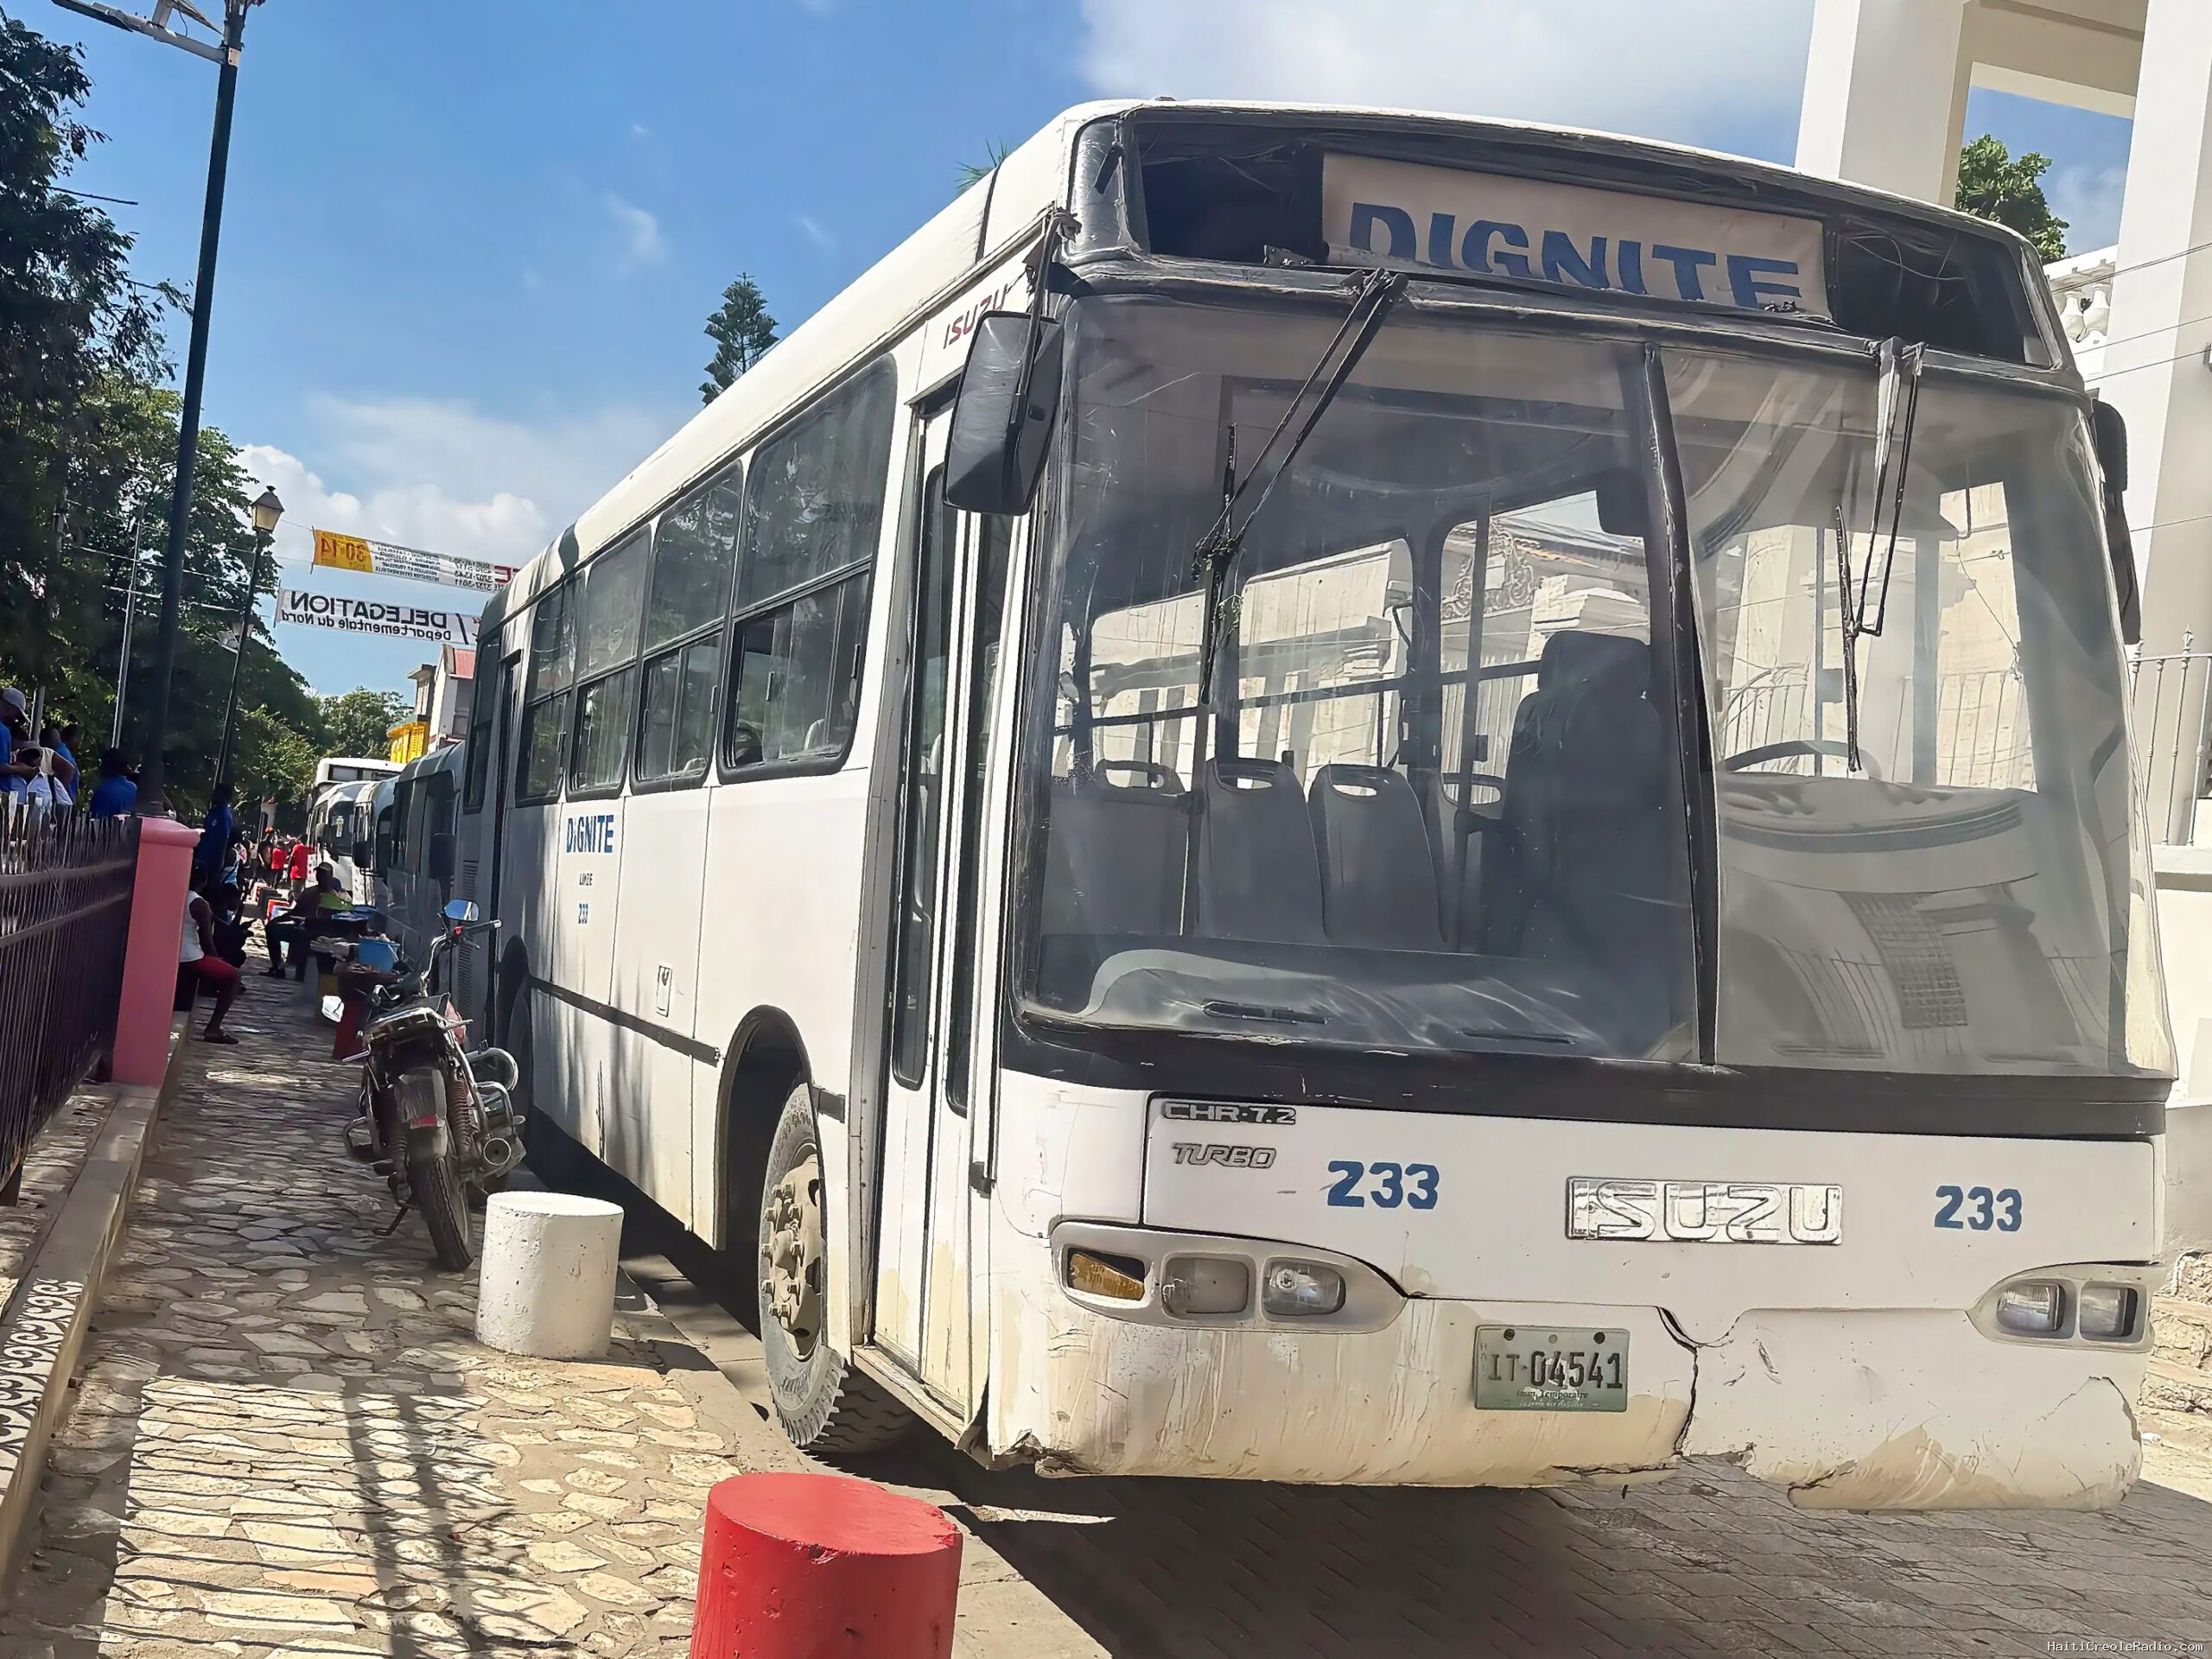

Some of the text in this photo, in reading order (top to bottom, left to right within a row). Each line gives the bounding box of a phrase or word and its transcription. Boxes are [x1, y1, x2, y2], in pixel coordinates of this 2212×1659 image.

[1348, 201, 1801, 308] DIGNITE
[943, 283, 1008, 349] ISUZU
[1171, 1141, 1277, 1169] TURBO
[1326, 1160, 1440, 1211] 233
[1567, 1179, 1841, 1243] ISUZU
[1933, 1185, 2024, 1232] 233
[1487, 1350, 1624, 1389] IT-04541
